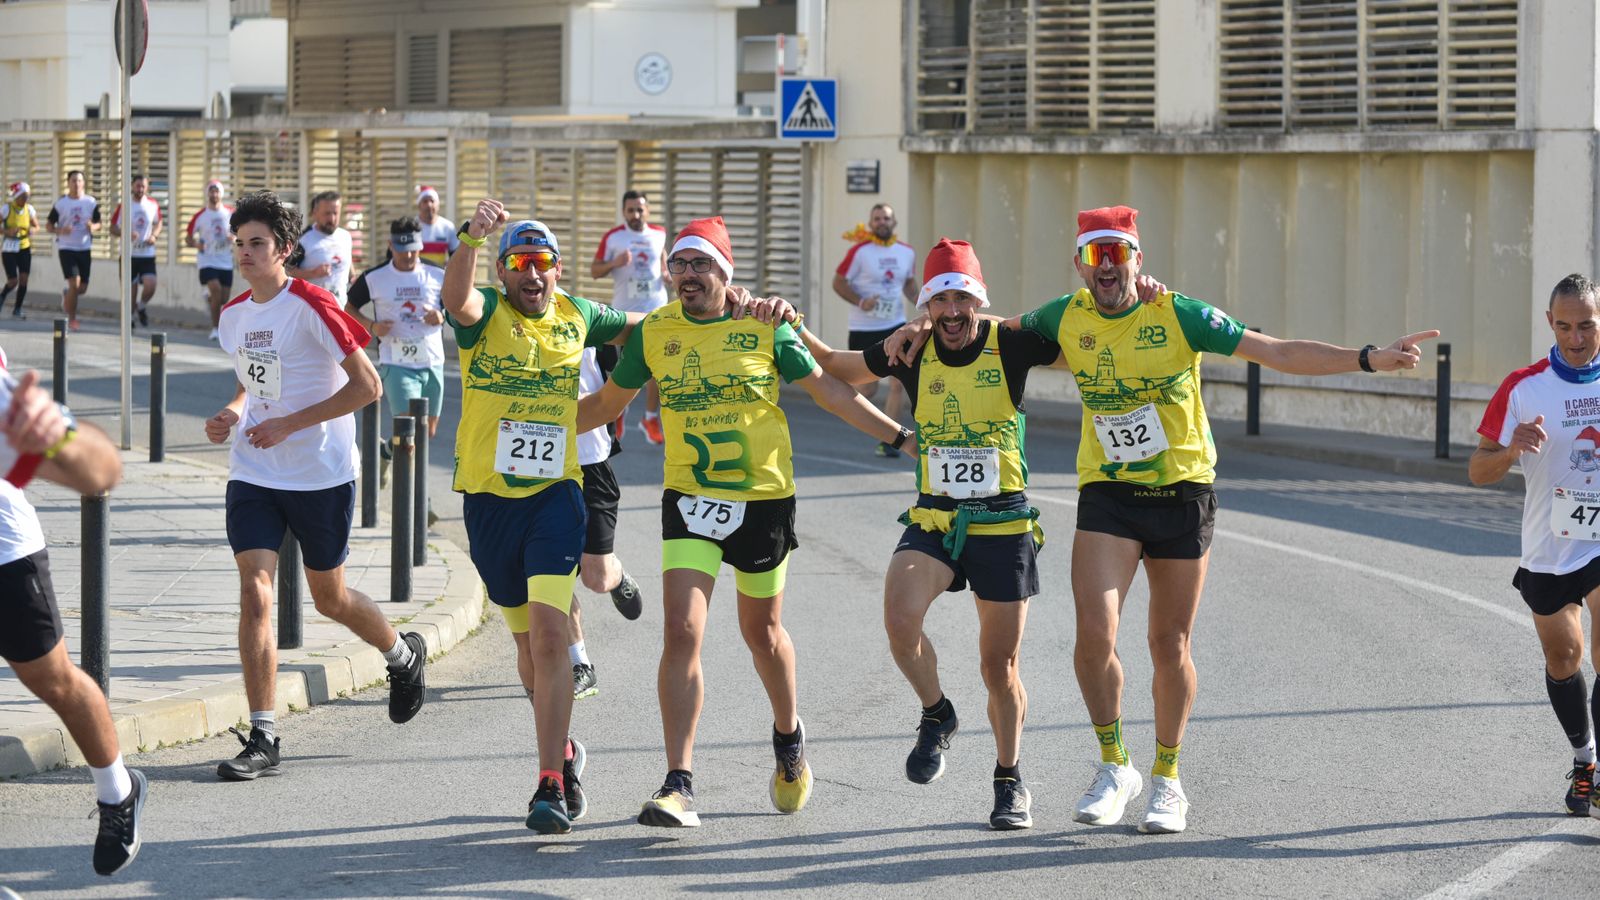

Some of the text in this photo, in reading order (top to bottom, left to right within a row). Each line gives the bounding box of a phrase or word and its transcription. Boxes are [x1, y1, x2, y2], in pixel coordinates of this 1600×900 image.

[250, 330, 273, 341] CARRERA
[253, 340, 272, 348] SILVESTRE
[402, 345, 418, 357] 99
[255, 352, 278, 360] SILVESTRE
[248, 363, 266, 384] 42
[1565, 397, 1600, 410] II CARRE
[1120, 405, 1151, 421] SILVESTRE
[1566, 407, 1600, 418] SAN SILVES
[536, 425, 564, 433] SILVESTRE
[1108, 424, 1151, 447] 132
[510, 438, 554, 461] 212
[941, 463, 985, 483] 128
[687, 500, 732, 525] 175
[1570, 505, 1600, 526] 47
